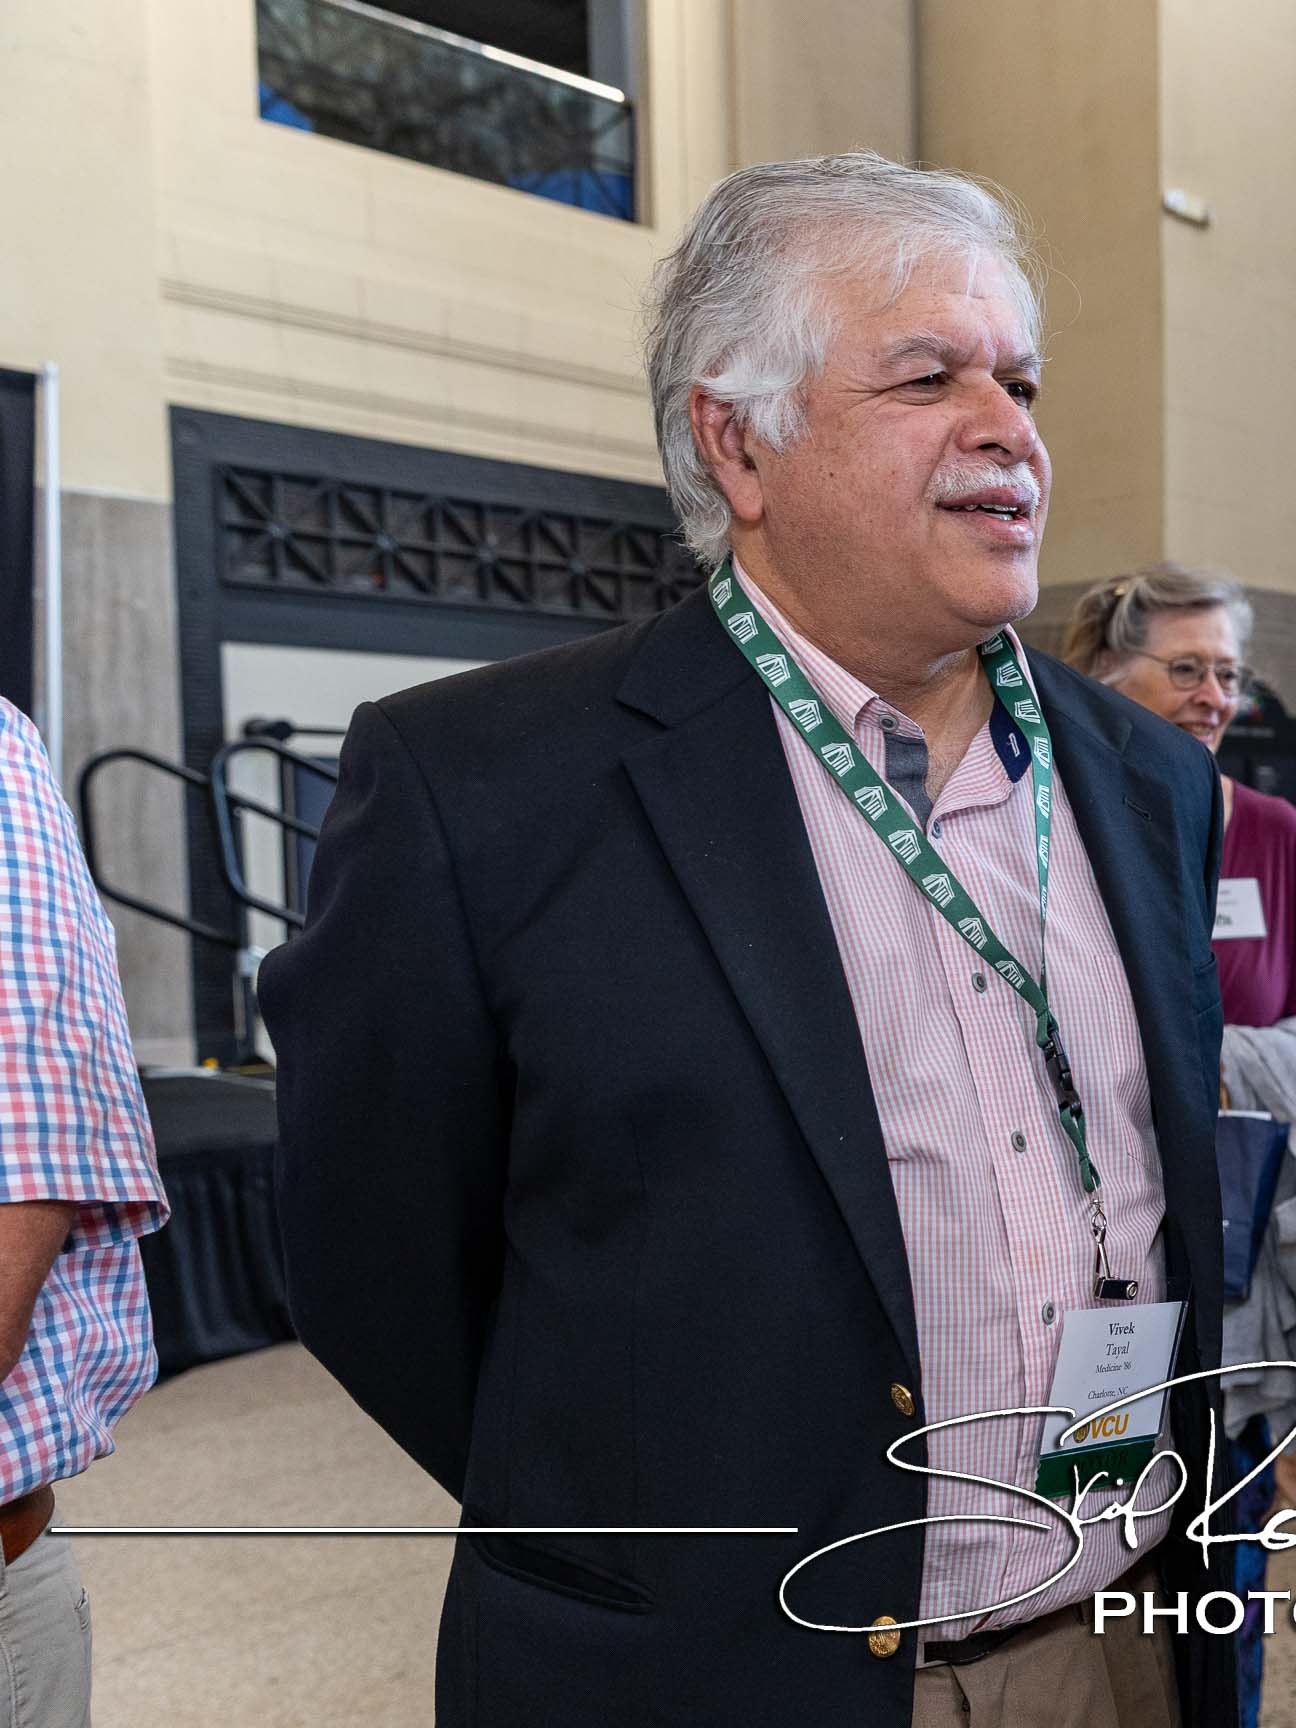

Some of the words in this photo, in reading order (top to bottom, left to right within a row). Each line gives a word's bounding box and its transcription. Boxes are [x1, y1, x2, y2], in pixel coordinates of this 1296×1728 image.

[1108, 1322, 1136, 1336] Vivek
[1106, 1341, 1131, 1359] Tayal
[1095, 1362, 1122, 1374] Medicine
[1090, 1413, 1130, 1439] VCU
